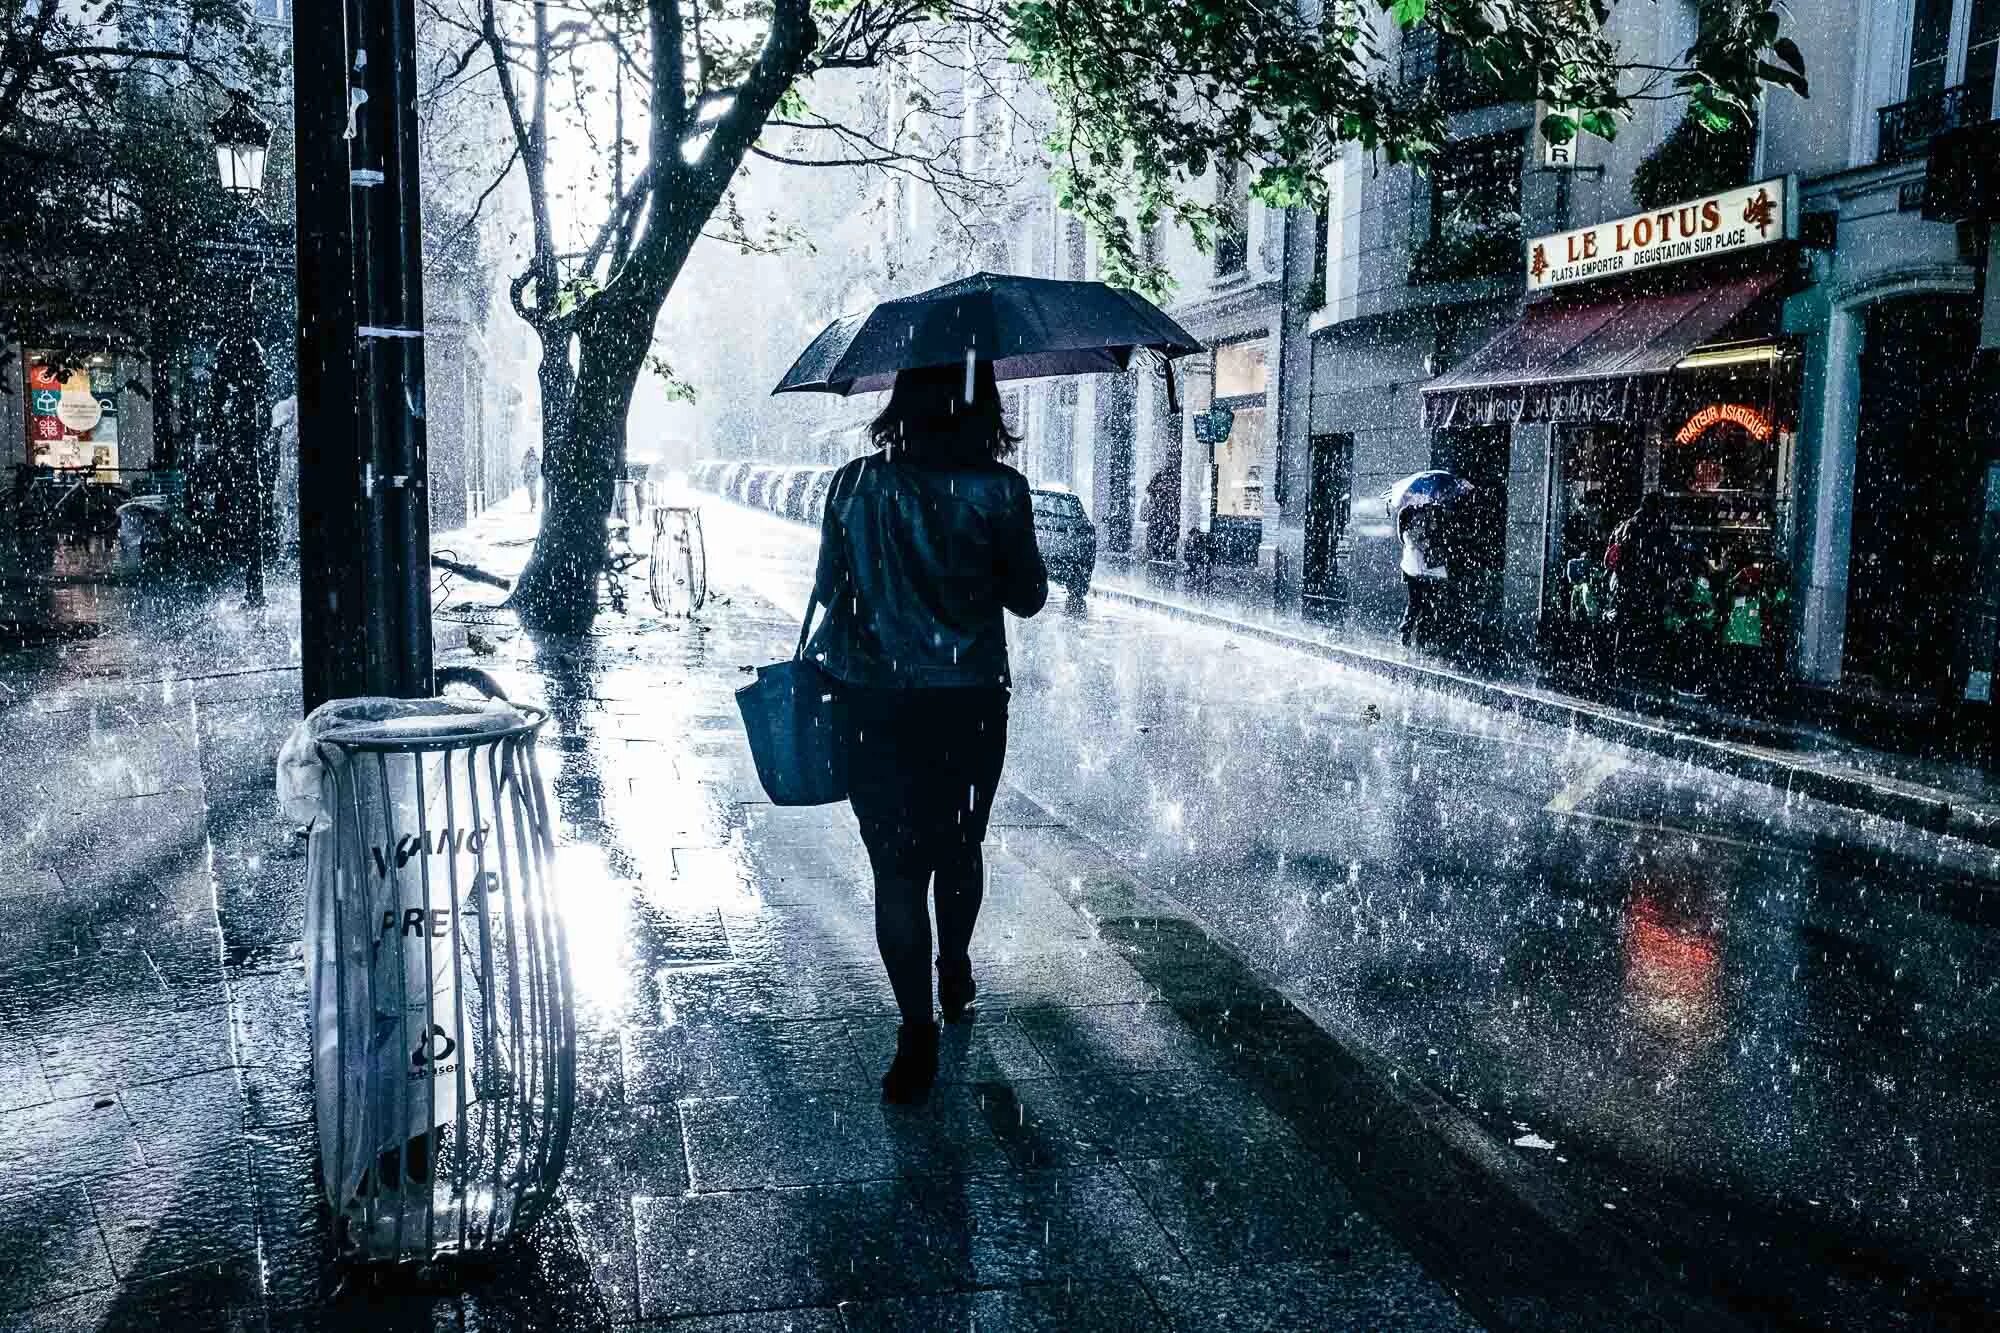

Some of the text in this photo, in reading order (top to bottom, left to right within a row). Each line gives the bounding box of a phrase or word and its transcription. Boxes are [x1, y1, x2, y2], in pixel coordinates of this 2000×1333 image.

[1551, 266, 1573, 282] PLATS
[1582, 255, 1624, 276] EMPORTER
[1634, 240, 1692, 265] DEGUSTATION
[1694, 236, 1713, 253] SUR
[1715, 228, 1746, 249] PLACE
[1567, 200, 1721, 263] LE LOTUS
[1466, 391, 1607, 423] CHINOIS JAPONAIS
[1675, 403, 1767, 445] TRAITEUR ASIATIQUE
